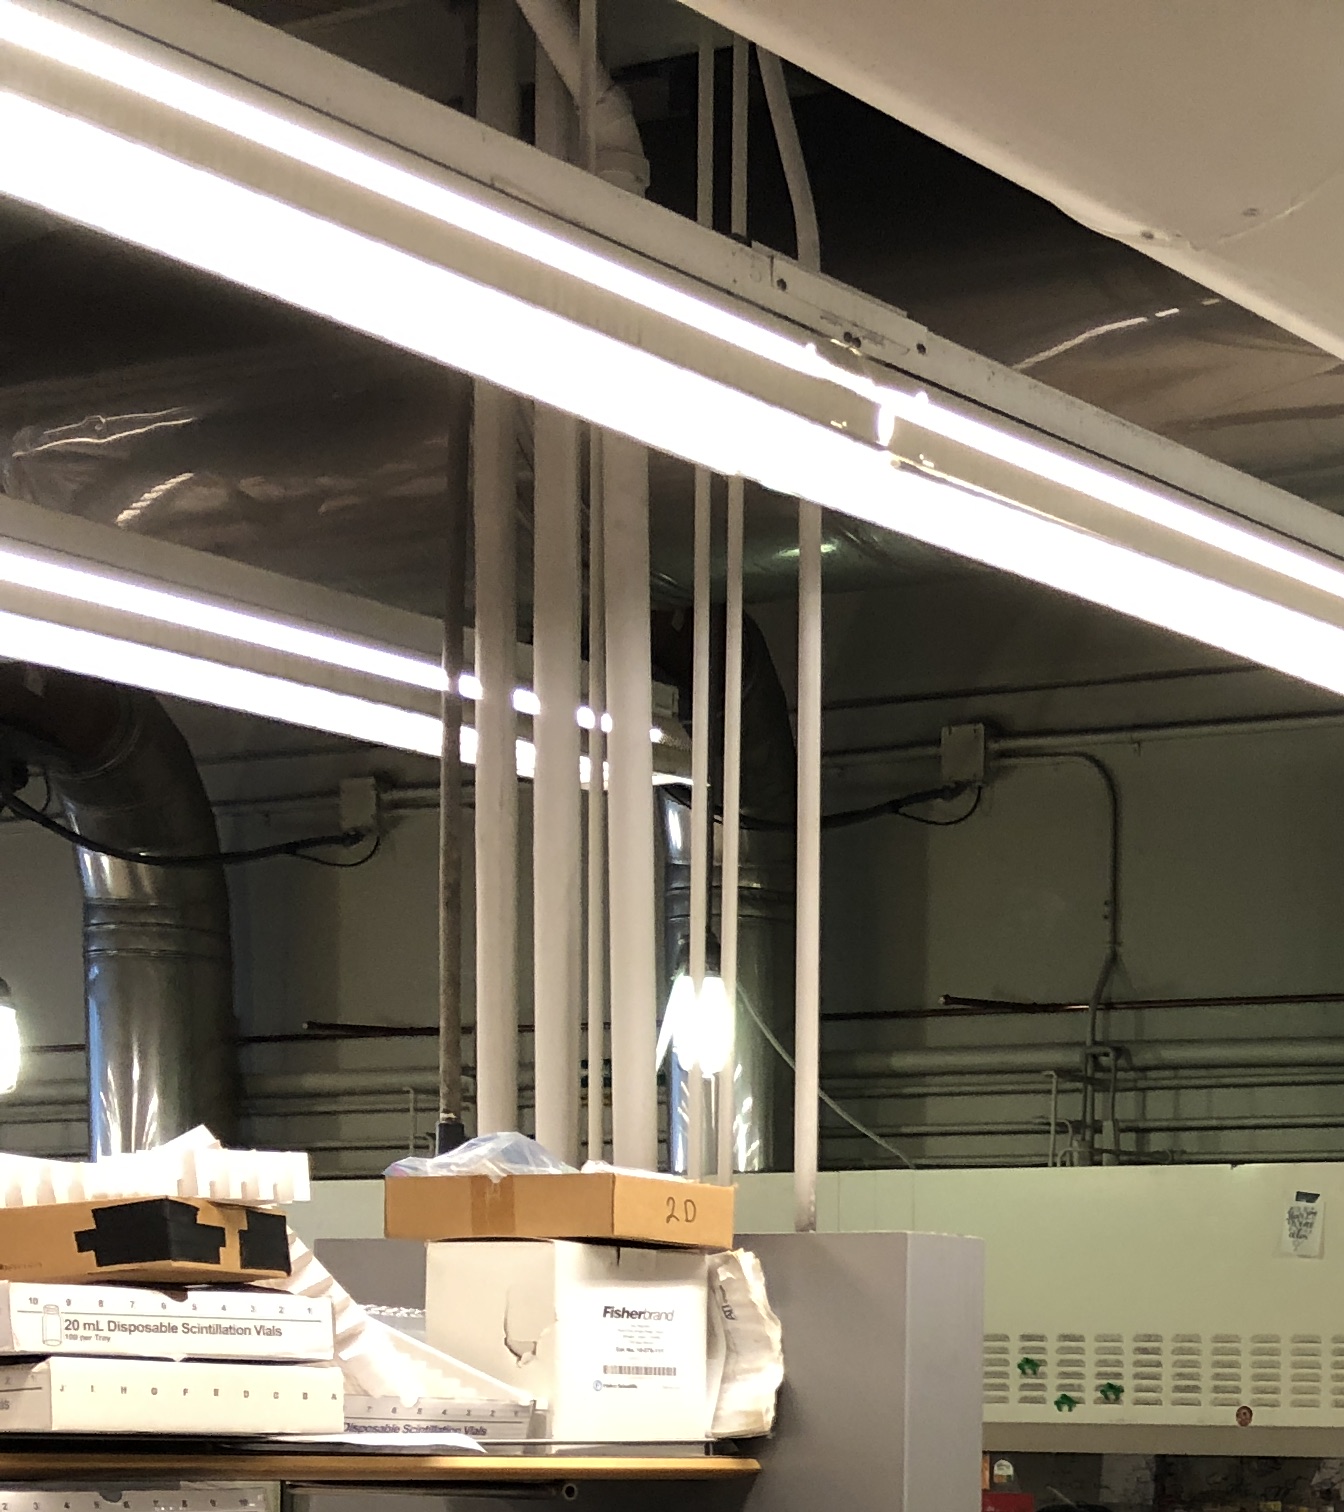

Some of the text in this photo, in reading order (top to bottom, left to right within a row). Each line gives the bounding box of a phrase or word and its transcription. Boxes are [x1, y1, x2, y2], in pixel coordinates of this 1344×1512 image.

[28, 1297, 39, 1305] 10
[98, 1299, 104, 1307] 8
[602, 1305, 675, 1321] Fisherbrand
[64, 1319, 282, 1337] 20 mL Disposable Scintillation Vials
[80, 1335, 92, 1344] per
[94, 1334, 111, 1343] Tray
[243, 1390, 250, 1398] D
[464, 1426, 487, 1435] Vials
